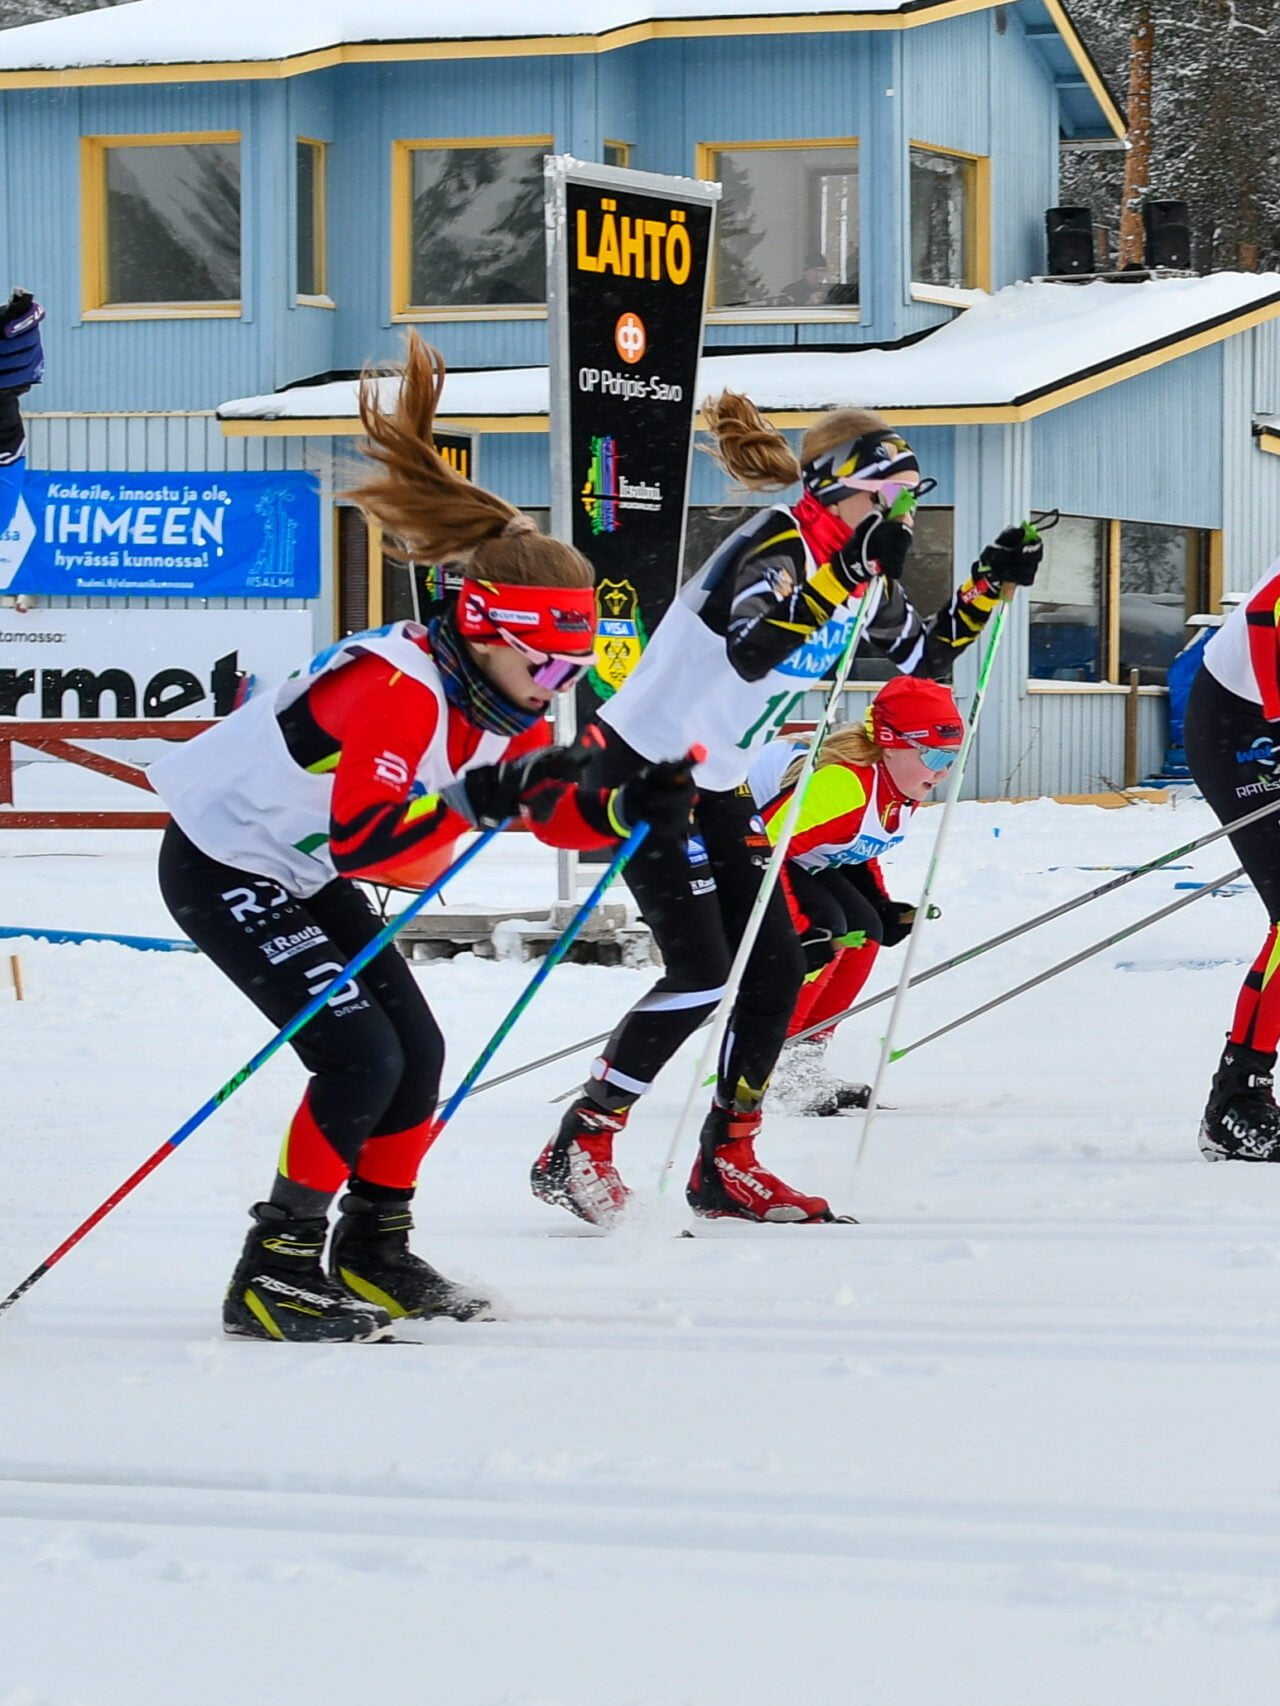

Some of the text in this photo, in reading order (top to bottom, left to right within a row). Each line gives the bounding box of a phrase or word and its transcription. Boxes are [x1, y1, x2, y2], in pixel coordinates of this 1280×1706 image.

[577, 198, 692, 286] LÄHTÖ
[579, 367, 683, 402] OP Pohjois-Savo
[48, 483, 228, 503] Kokeile, innostu ja ole
[44, 504, 225, 546] IHMEEN
[55, 549, 209, 570] hyvässä kunnossa!
[713, 1156, 773, 1201] alpina
[251, 1275, 338, 1308] FISCHER
